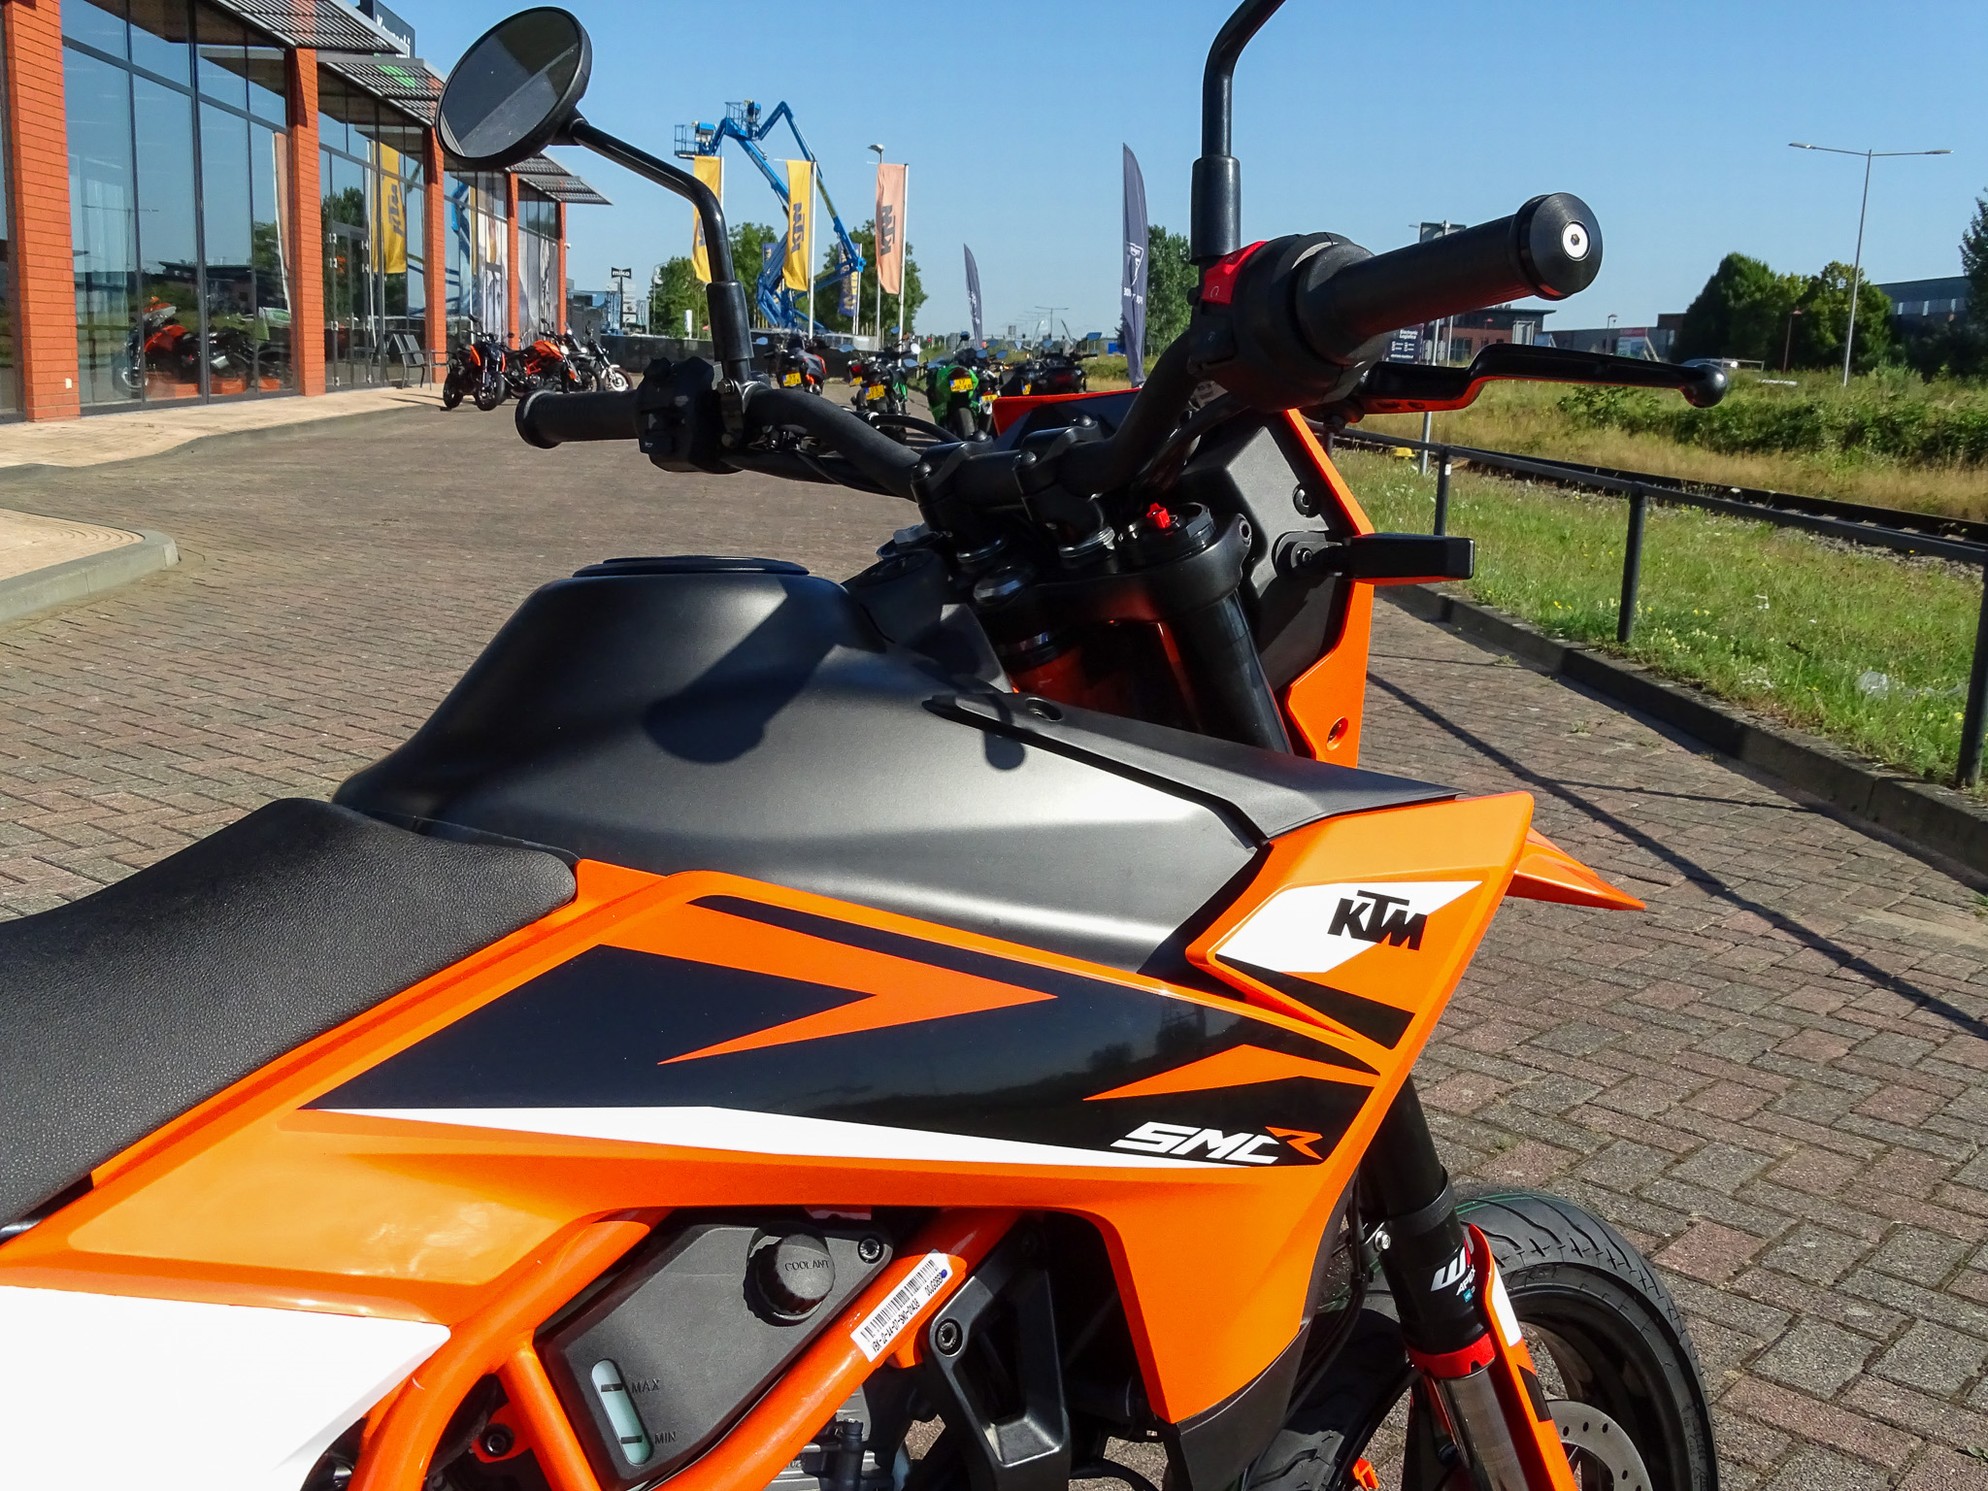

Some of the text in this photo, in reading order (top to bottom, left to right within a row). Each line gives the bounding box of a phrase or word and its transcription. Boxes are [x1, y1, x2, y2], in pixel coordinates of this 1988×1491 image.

[1327, 889, 1428, 951] KTM
[784, 1259, 829, 1272] COOLANT
[631, 1378, 660, 1393] MAX
[654, 1431, 676, 1445] MIN
